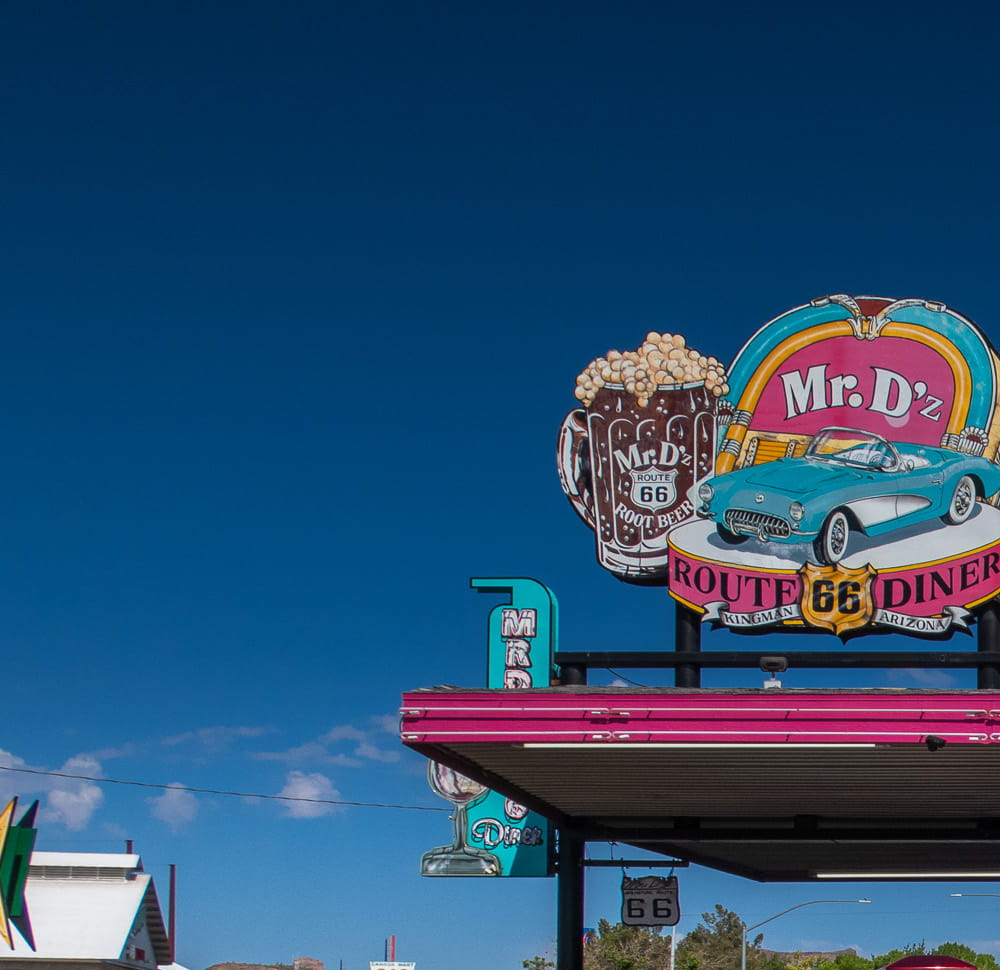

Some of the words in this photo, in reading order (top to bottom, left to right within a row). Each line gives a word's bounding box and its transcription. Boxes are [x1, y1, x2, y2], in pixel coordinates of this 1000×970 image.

[780, 363, 863, 421] Mr.
[871, 366, 945, 422] D'z
[636, 473, 671, 482] ROUTE
[640, 486, 668, 502] 66
[615, 502, 653, 529] ROOT
[657, 499, 695, 528] BEER
[673, 556, 799, 607] ROUTE
[811, 580, 862, 614] 66
[883, 552, 1000, 608] DINER
[723, 606, 794, 624] KINGMAN
[879, 612, 948, 631] ARIZONA
[627, 898, 672, 918] 66
